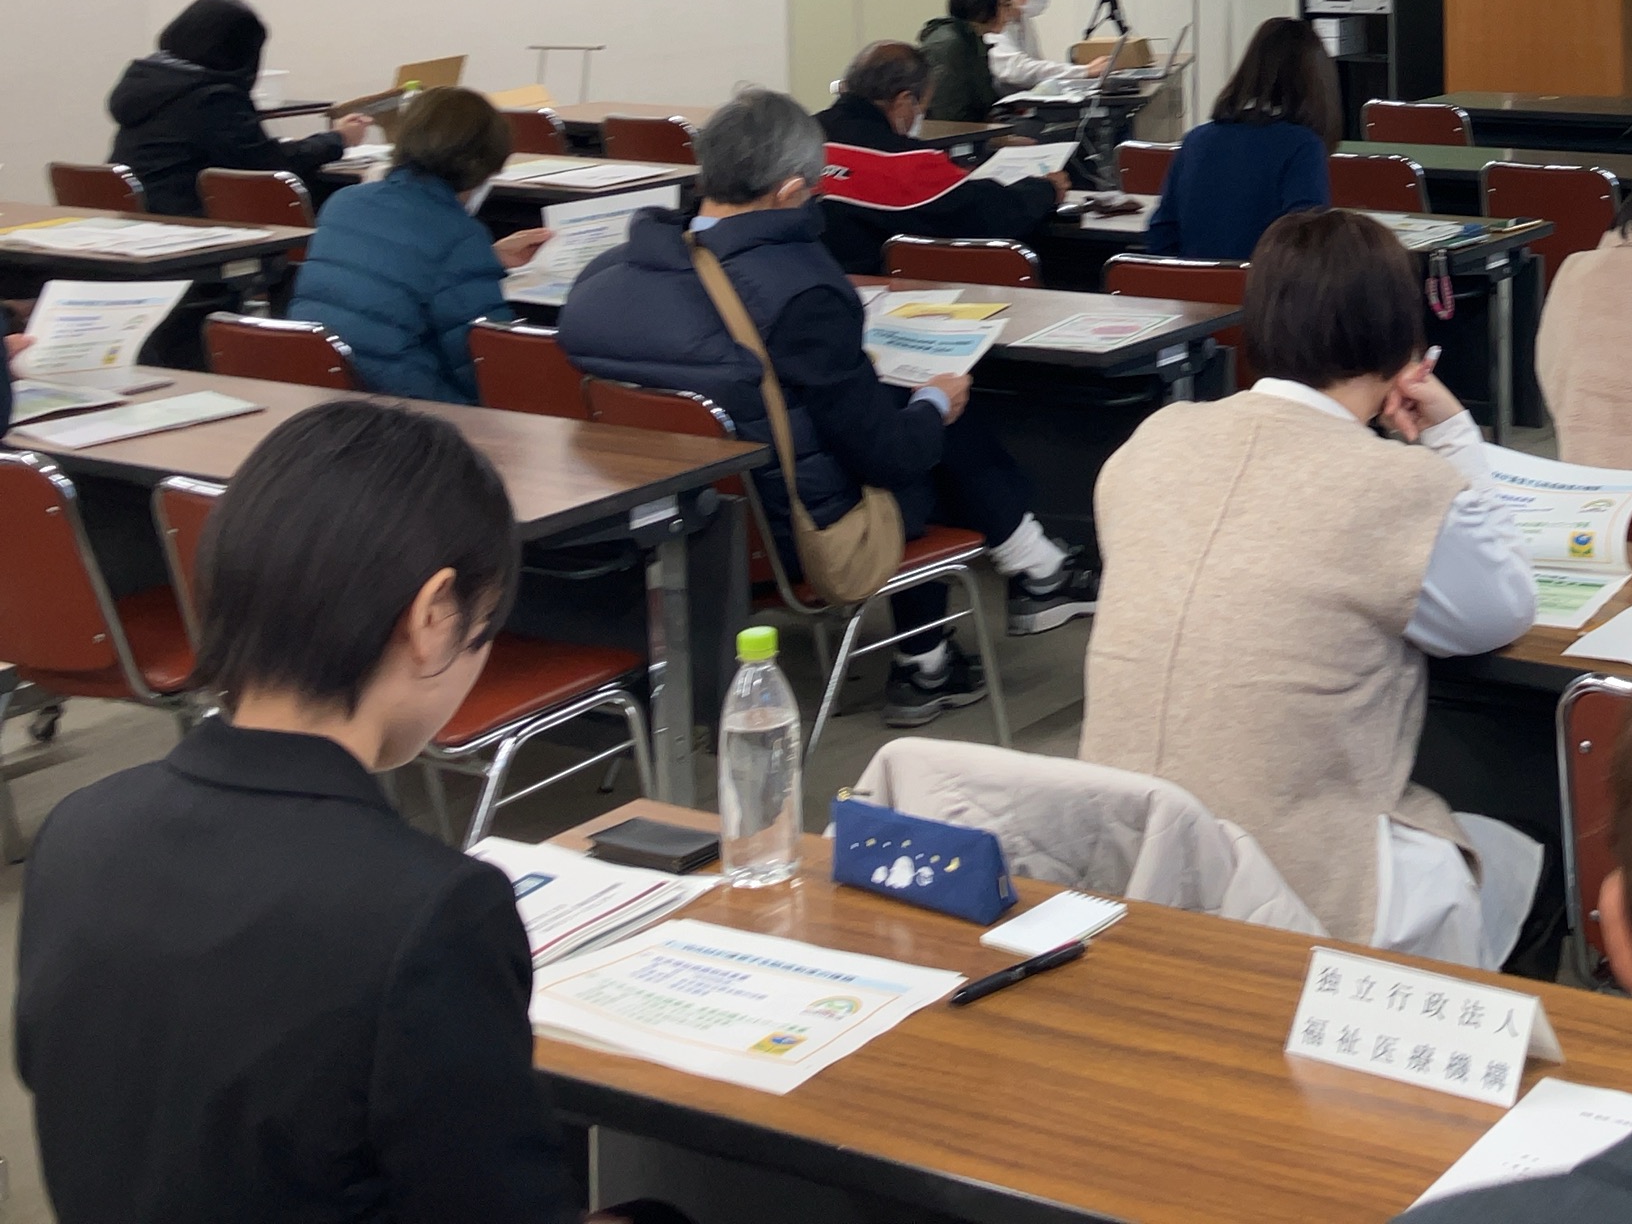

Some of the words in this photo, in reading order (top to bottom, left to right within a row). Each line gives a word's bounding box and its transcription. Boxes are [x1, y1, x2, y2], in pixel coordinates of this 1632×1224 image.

[1314, 966, 1520, 1039] 独立行政法人
[1301, 1016, 1511, 1093] 福祉医療機構
